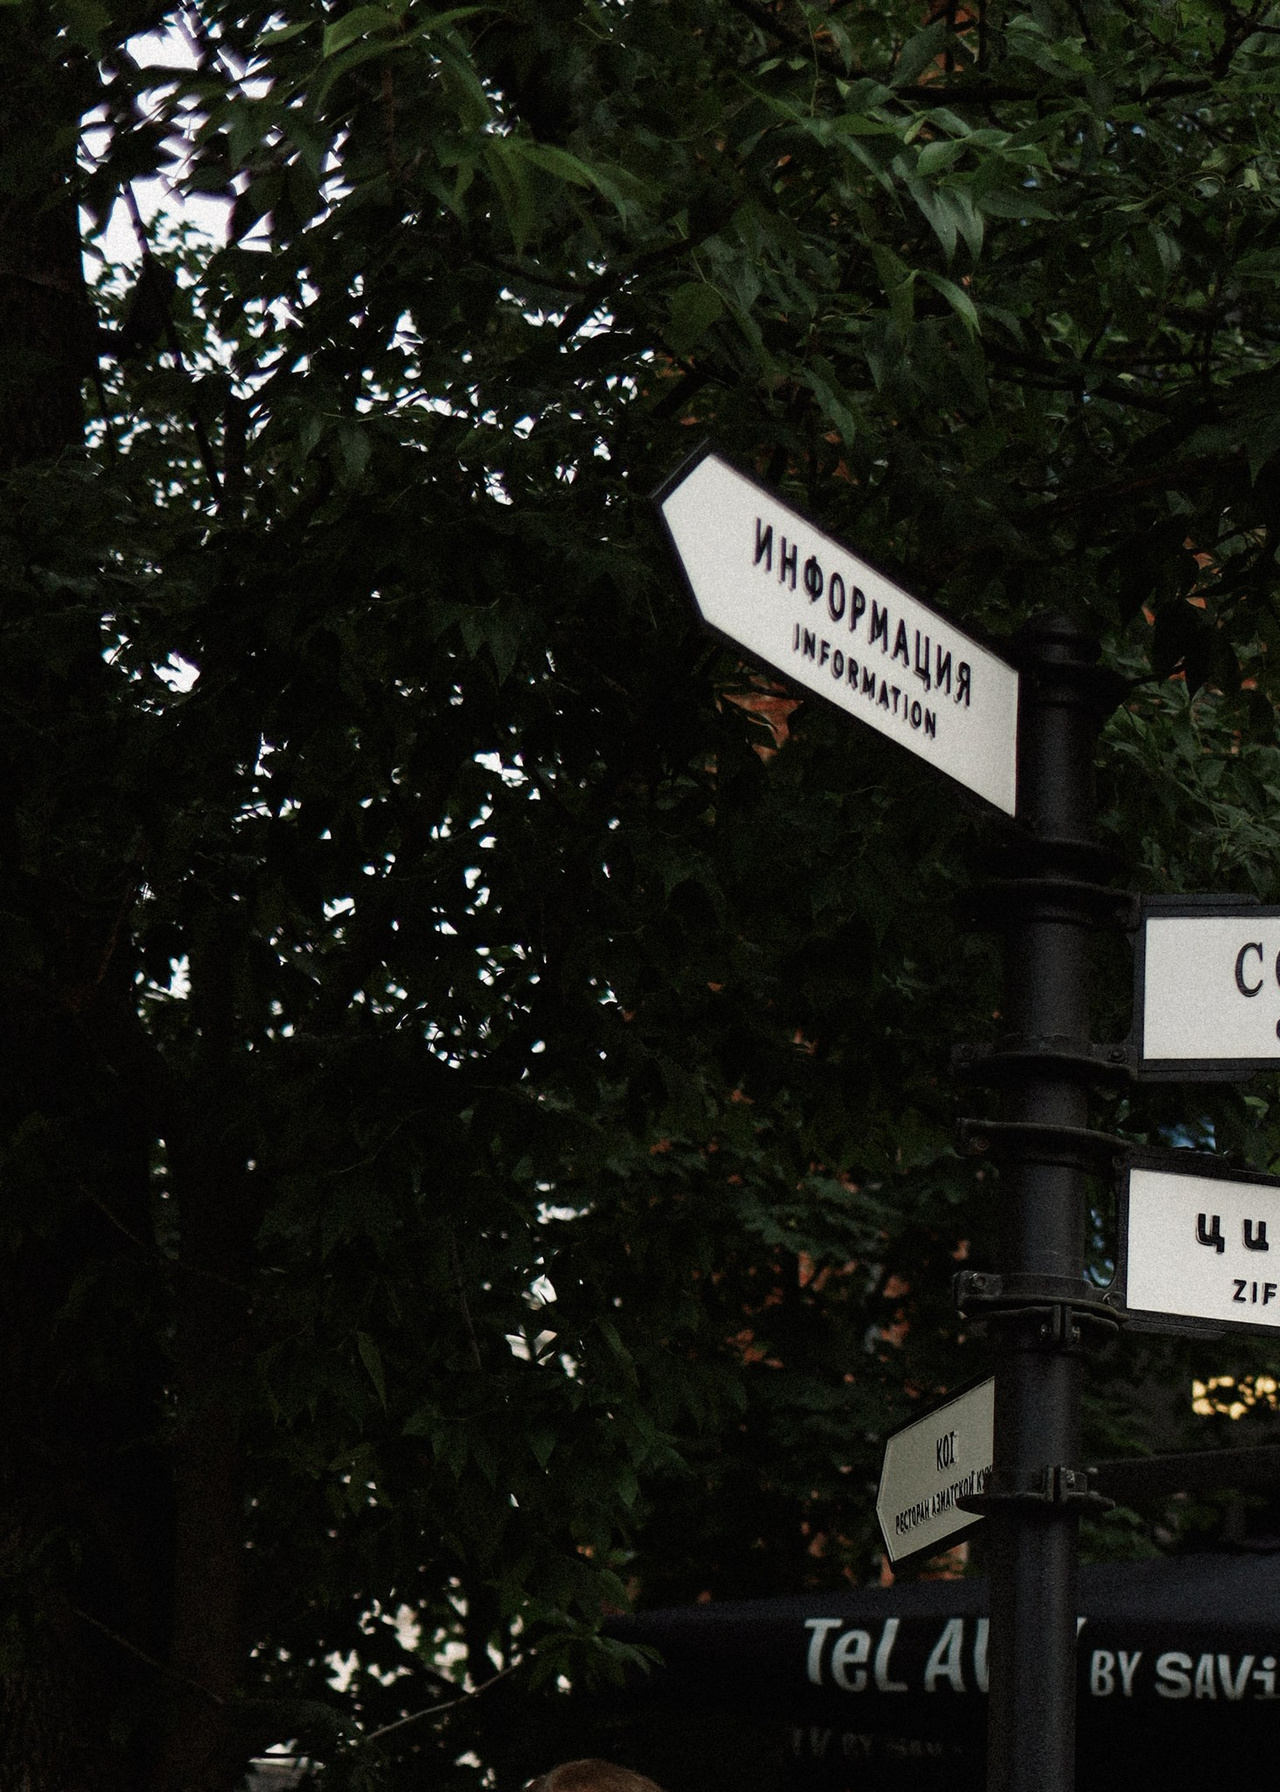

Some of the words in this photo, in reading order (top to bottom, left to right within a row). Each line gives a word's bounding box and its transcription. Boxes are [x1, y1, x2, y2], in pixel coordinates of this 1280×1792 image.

[753, 517, 972, 707] ИНФОРМАЦИЯ
[793, 623, 937, 739] INFORMATION
[895, 1499, 930, 1536] РЕСТОРАН
[1091, 1650, 1143, 1698] BY
